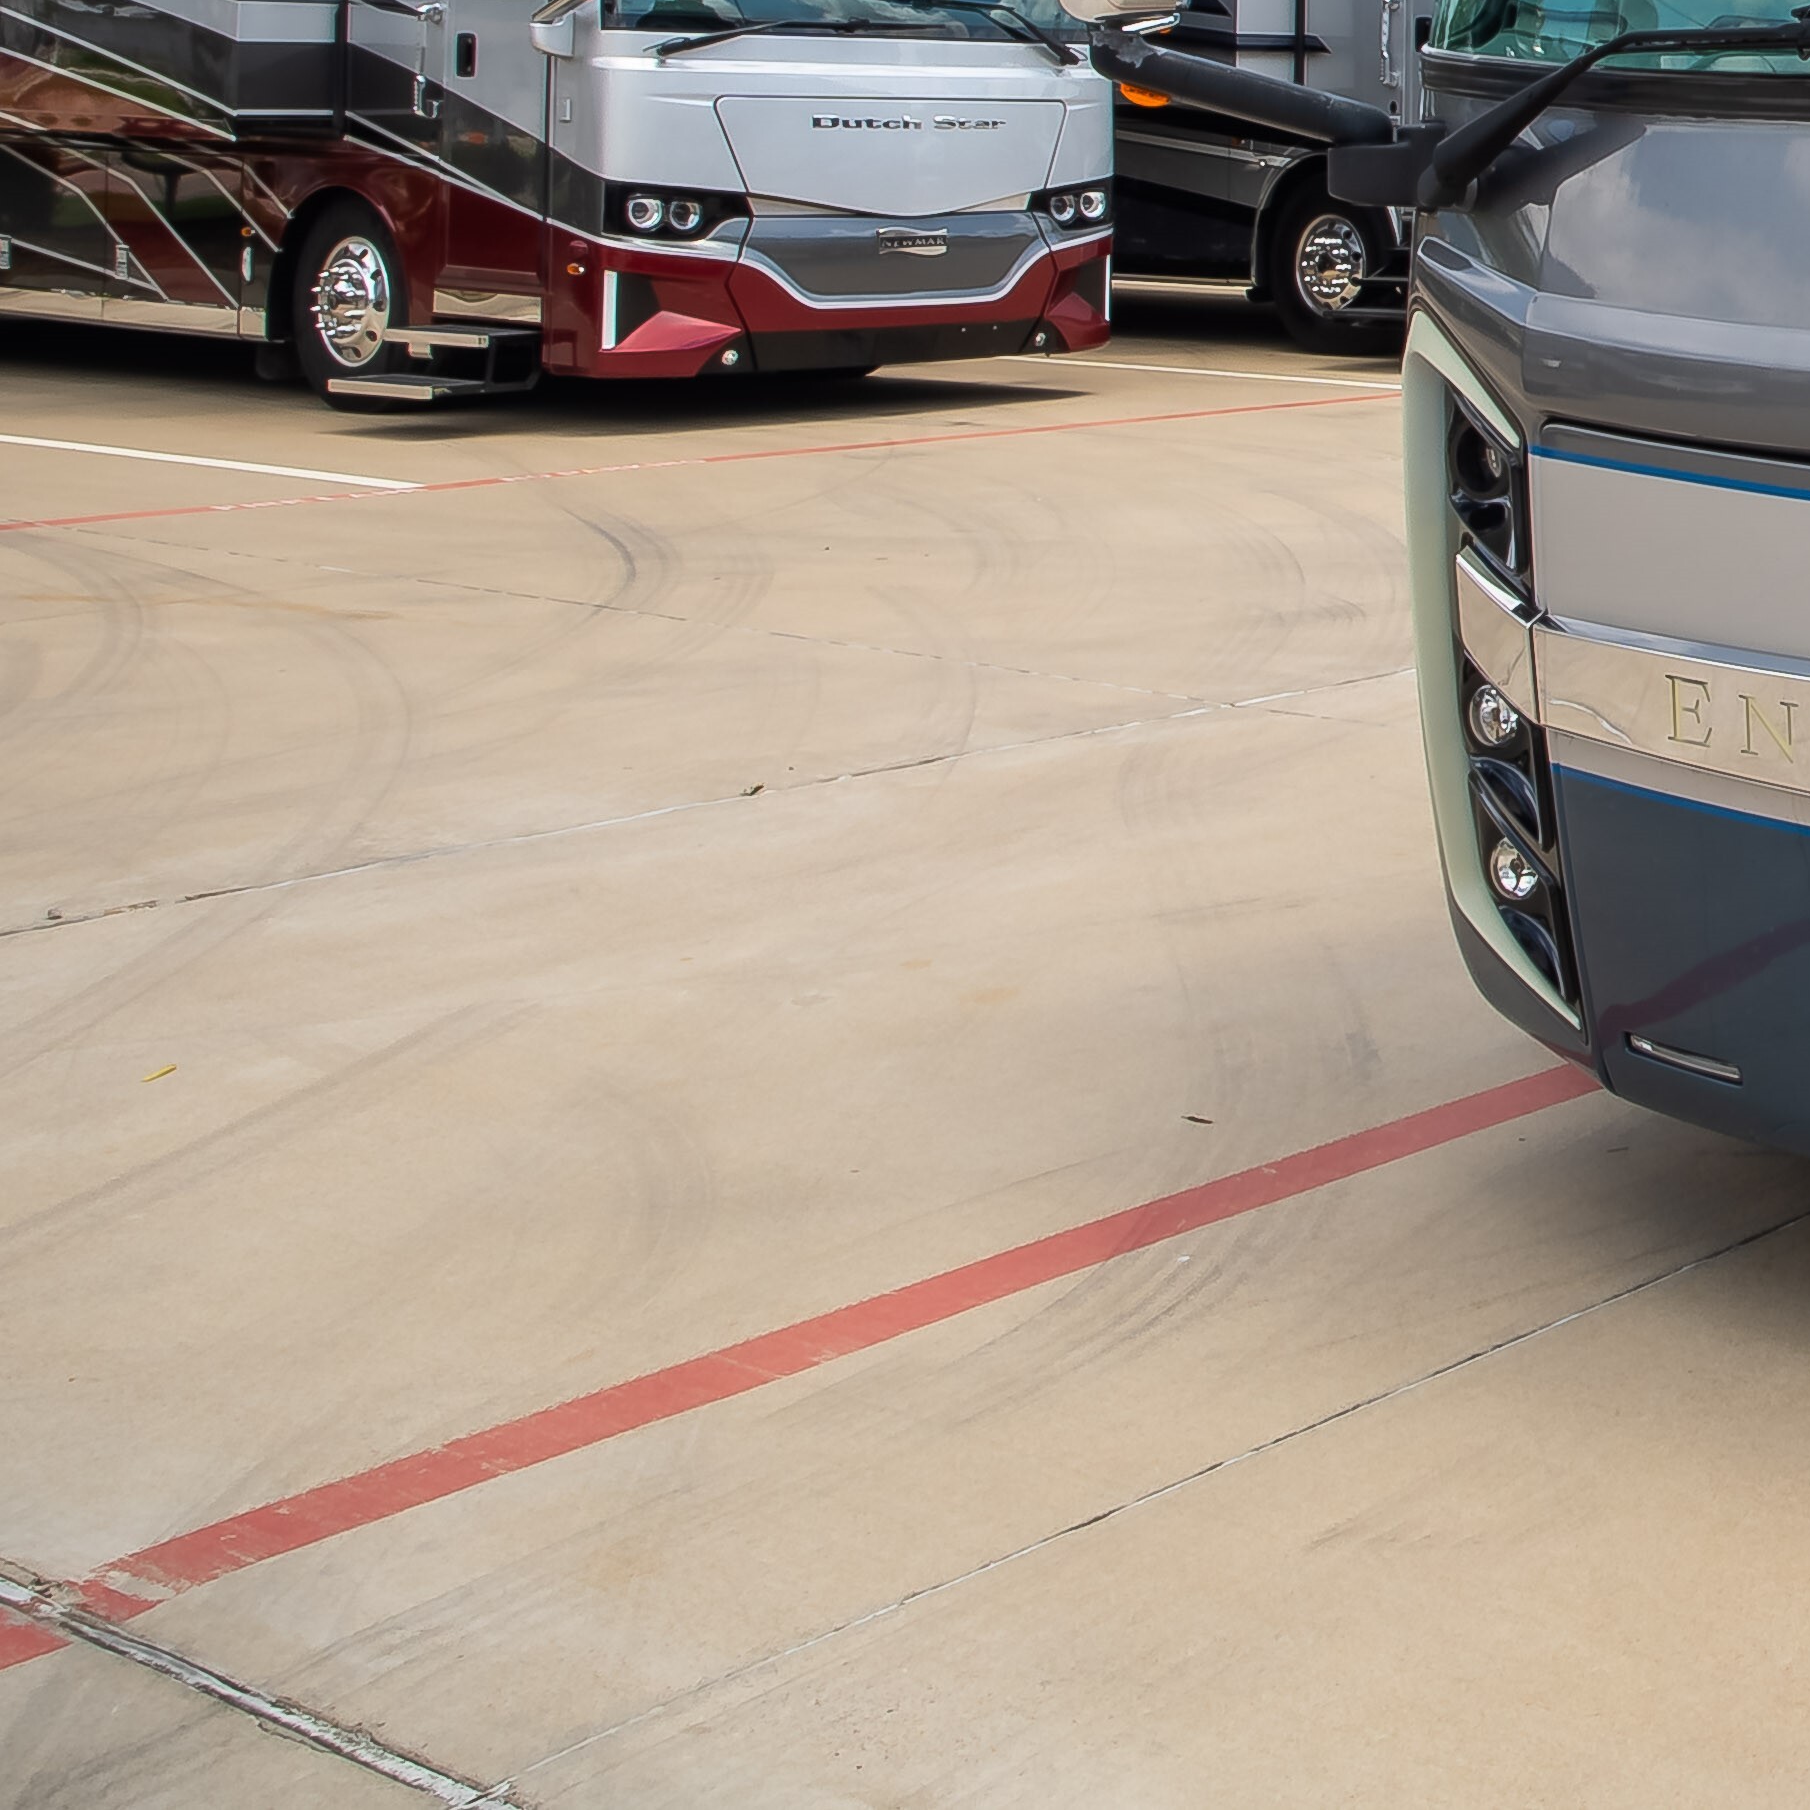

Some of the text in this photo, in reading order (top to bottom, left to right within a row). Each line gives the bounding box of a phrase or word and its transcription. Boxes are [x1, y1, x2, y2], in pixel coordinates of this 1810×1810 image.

[812, 114, 1006, 130] Dutch Star
[881, 237, 945, 248] NEWMAR
